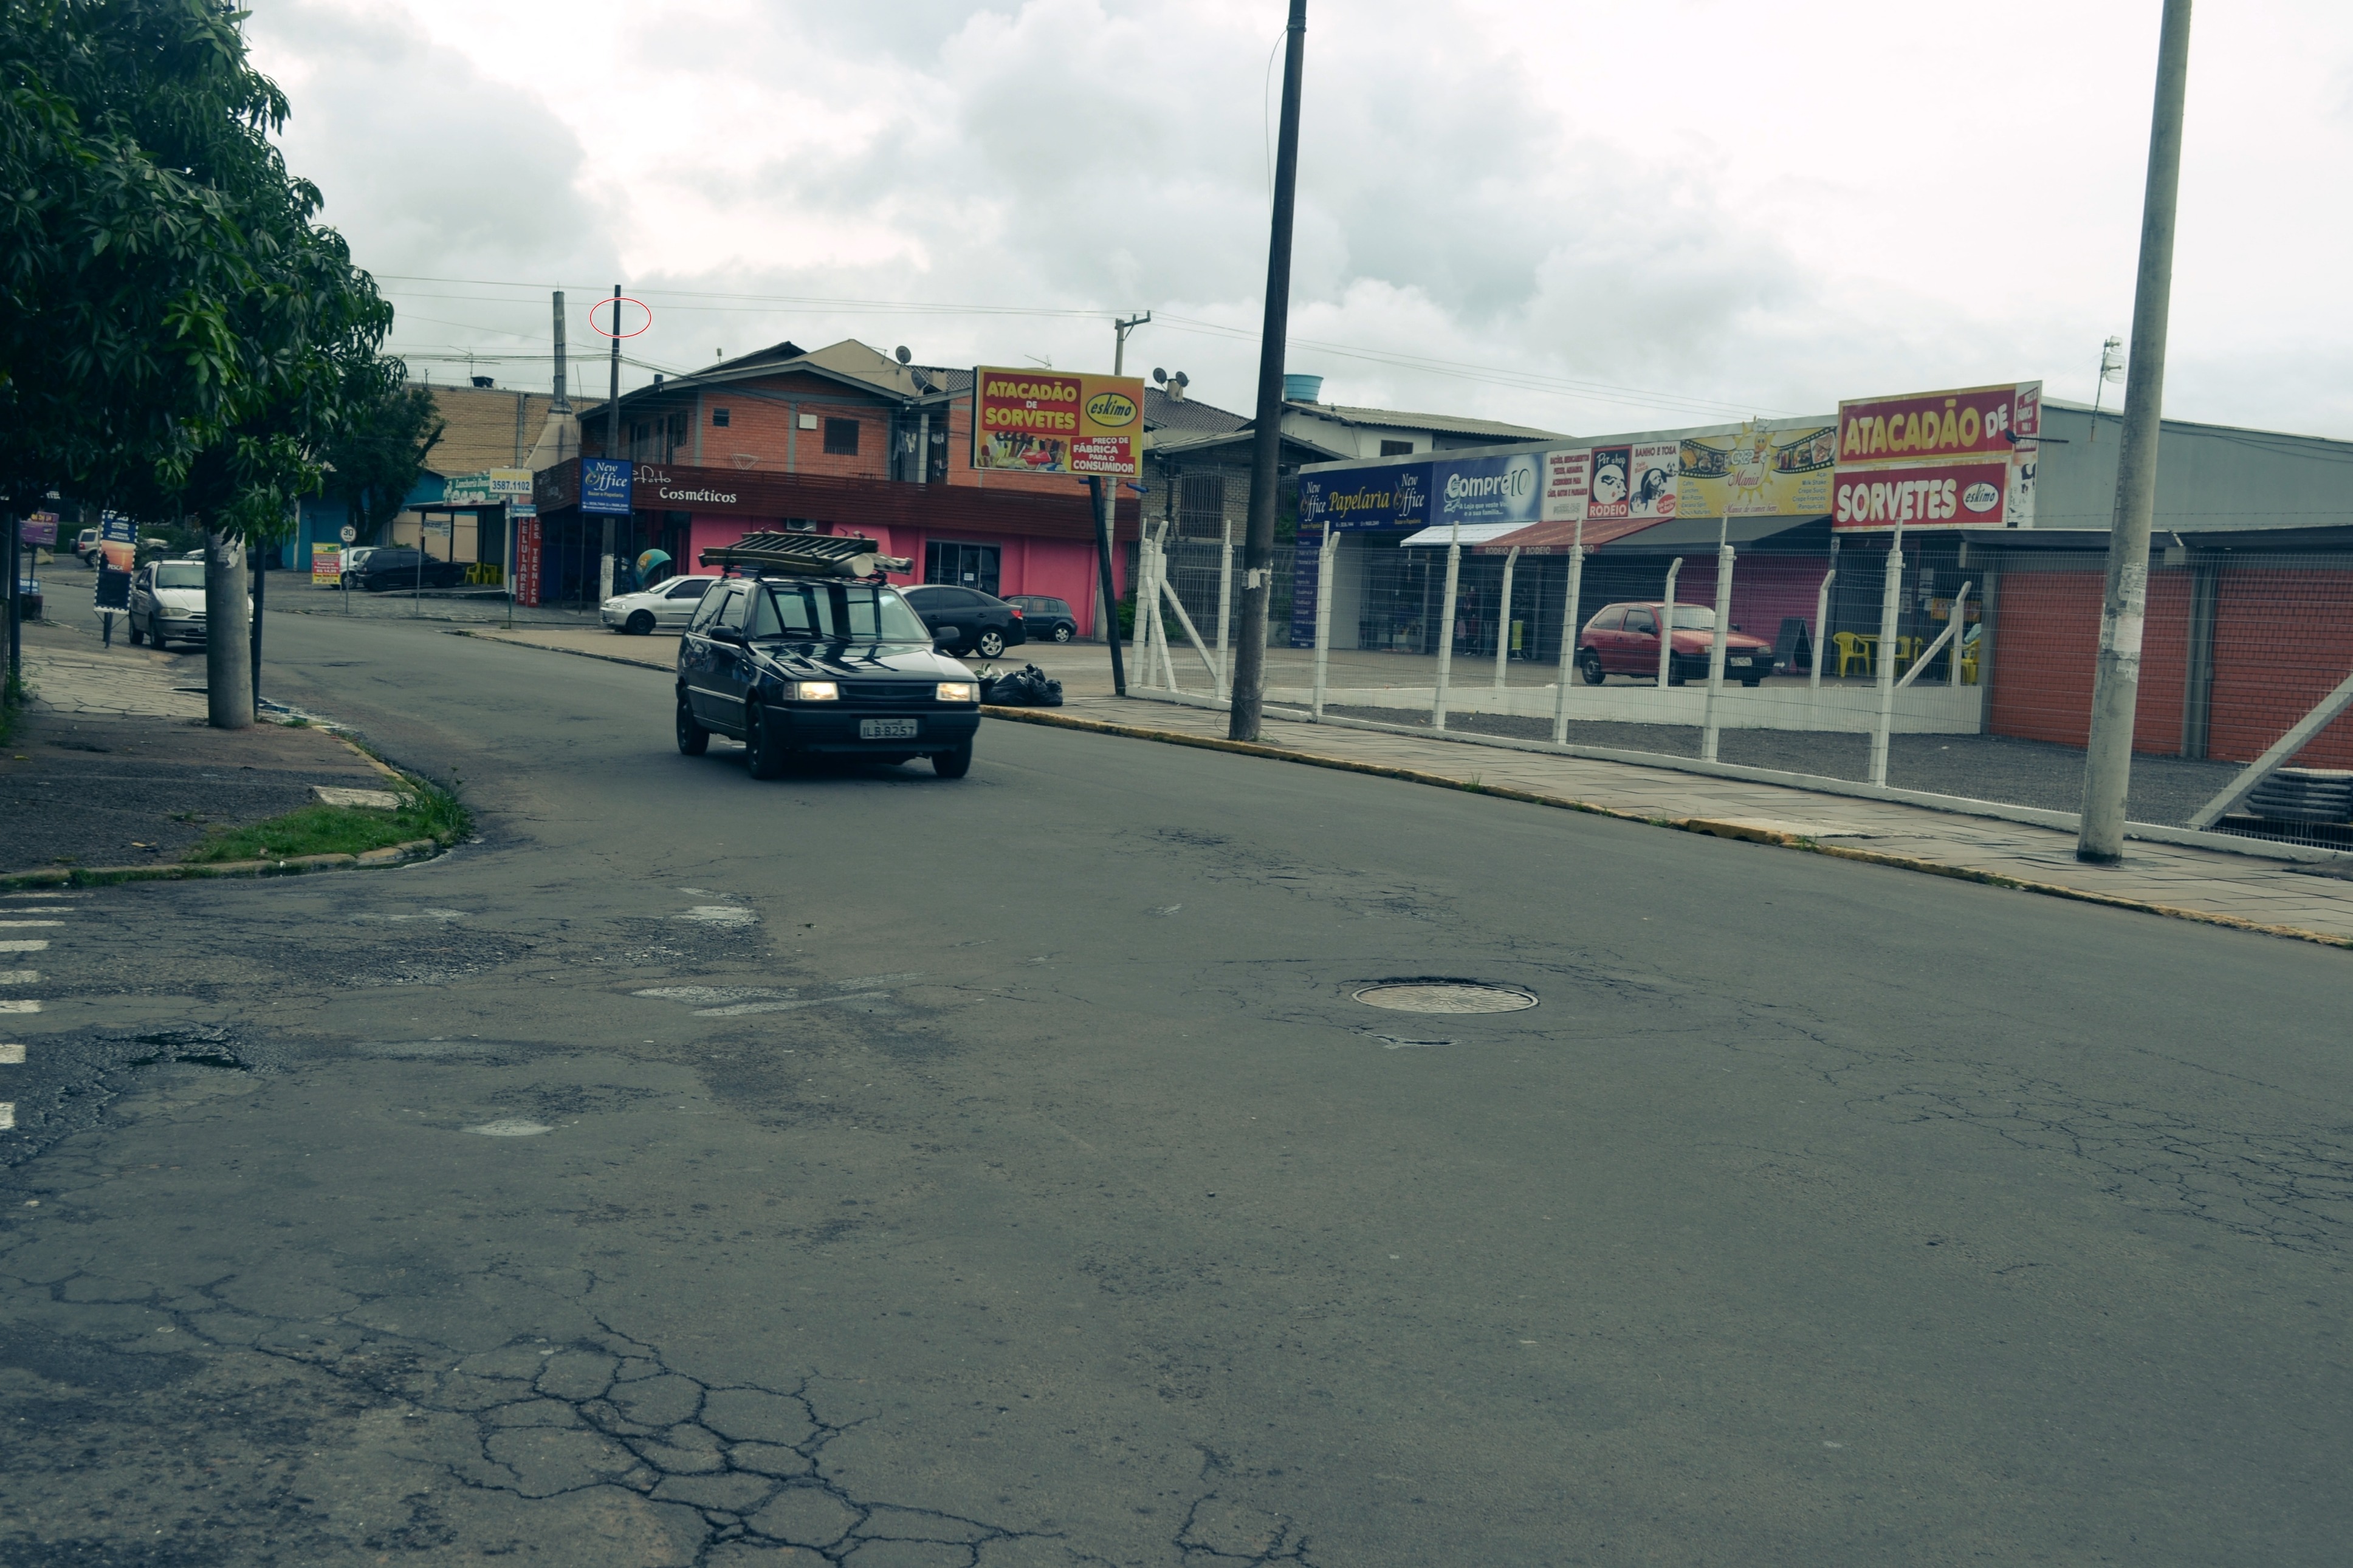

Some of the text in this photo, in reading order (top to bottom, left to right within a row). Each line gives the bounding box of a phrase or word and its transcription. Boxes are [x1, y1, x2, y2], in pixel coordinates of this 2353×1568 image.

[986, 381, 1077, 403] ATACADÃO
[1026, 400, 1037, 409] DE
[985, 408, 1076, 430] SORVETES
[1843, 399, 2009, 456] ATACADÃO DE
[1073, 442, 1118, 454] FÁBRICA
[1635, 446, 1677, 457] BANHO E TOSA
[596, 462, 618, 471] New
[1073, 460, 1134, 474] CONSUMIDOR
[1611, 453, 1626, 468] shop
[492, 481, 530, 490] 3587.1102
[585, 472, 628, 491] Office
[1401, 473, 1418, 487] New
[1728, 469, 1760, 487] Mania
[659, 487, 737, 503] Cosméticos
[1307, 482, 1321, 494] New
[1329, 487, 1390, 518] Papelaria
[1393, 488, 1424, 516] Office
[1836, 478, 1957, 522] SORVETES
[1300, 495, 1326, 521] Office
[1590, 504, 1627, 516] RODEIO
[343, 528, 354, 536] 30
[519, 517, 528, 601] CELULARES
